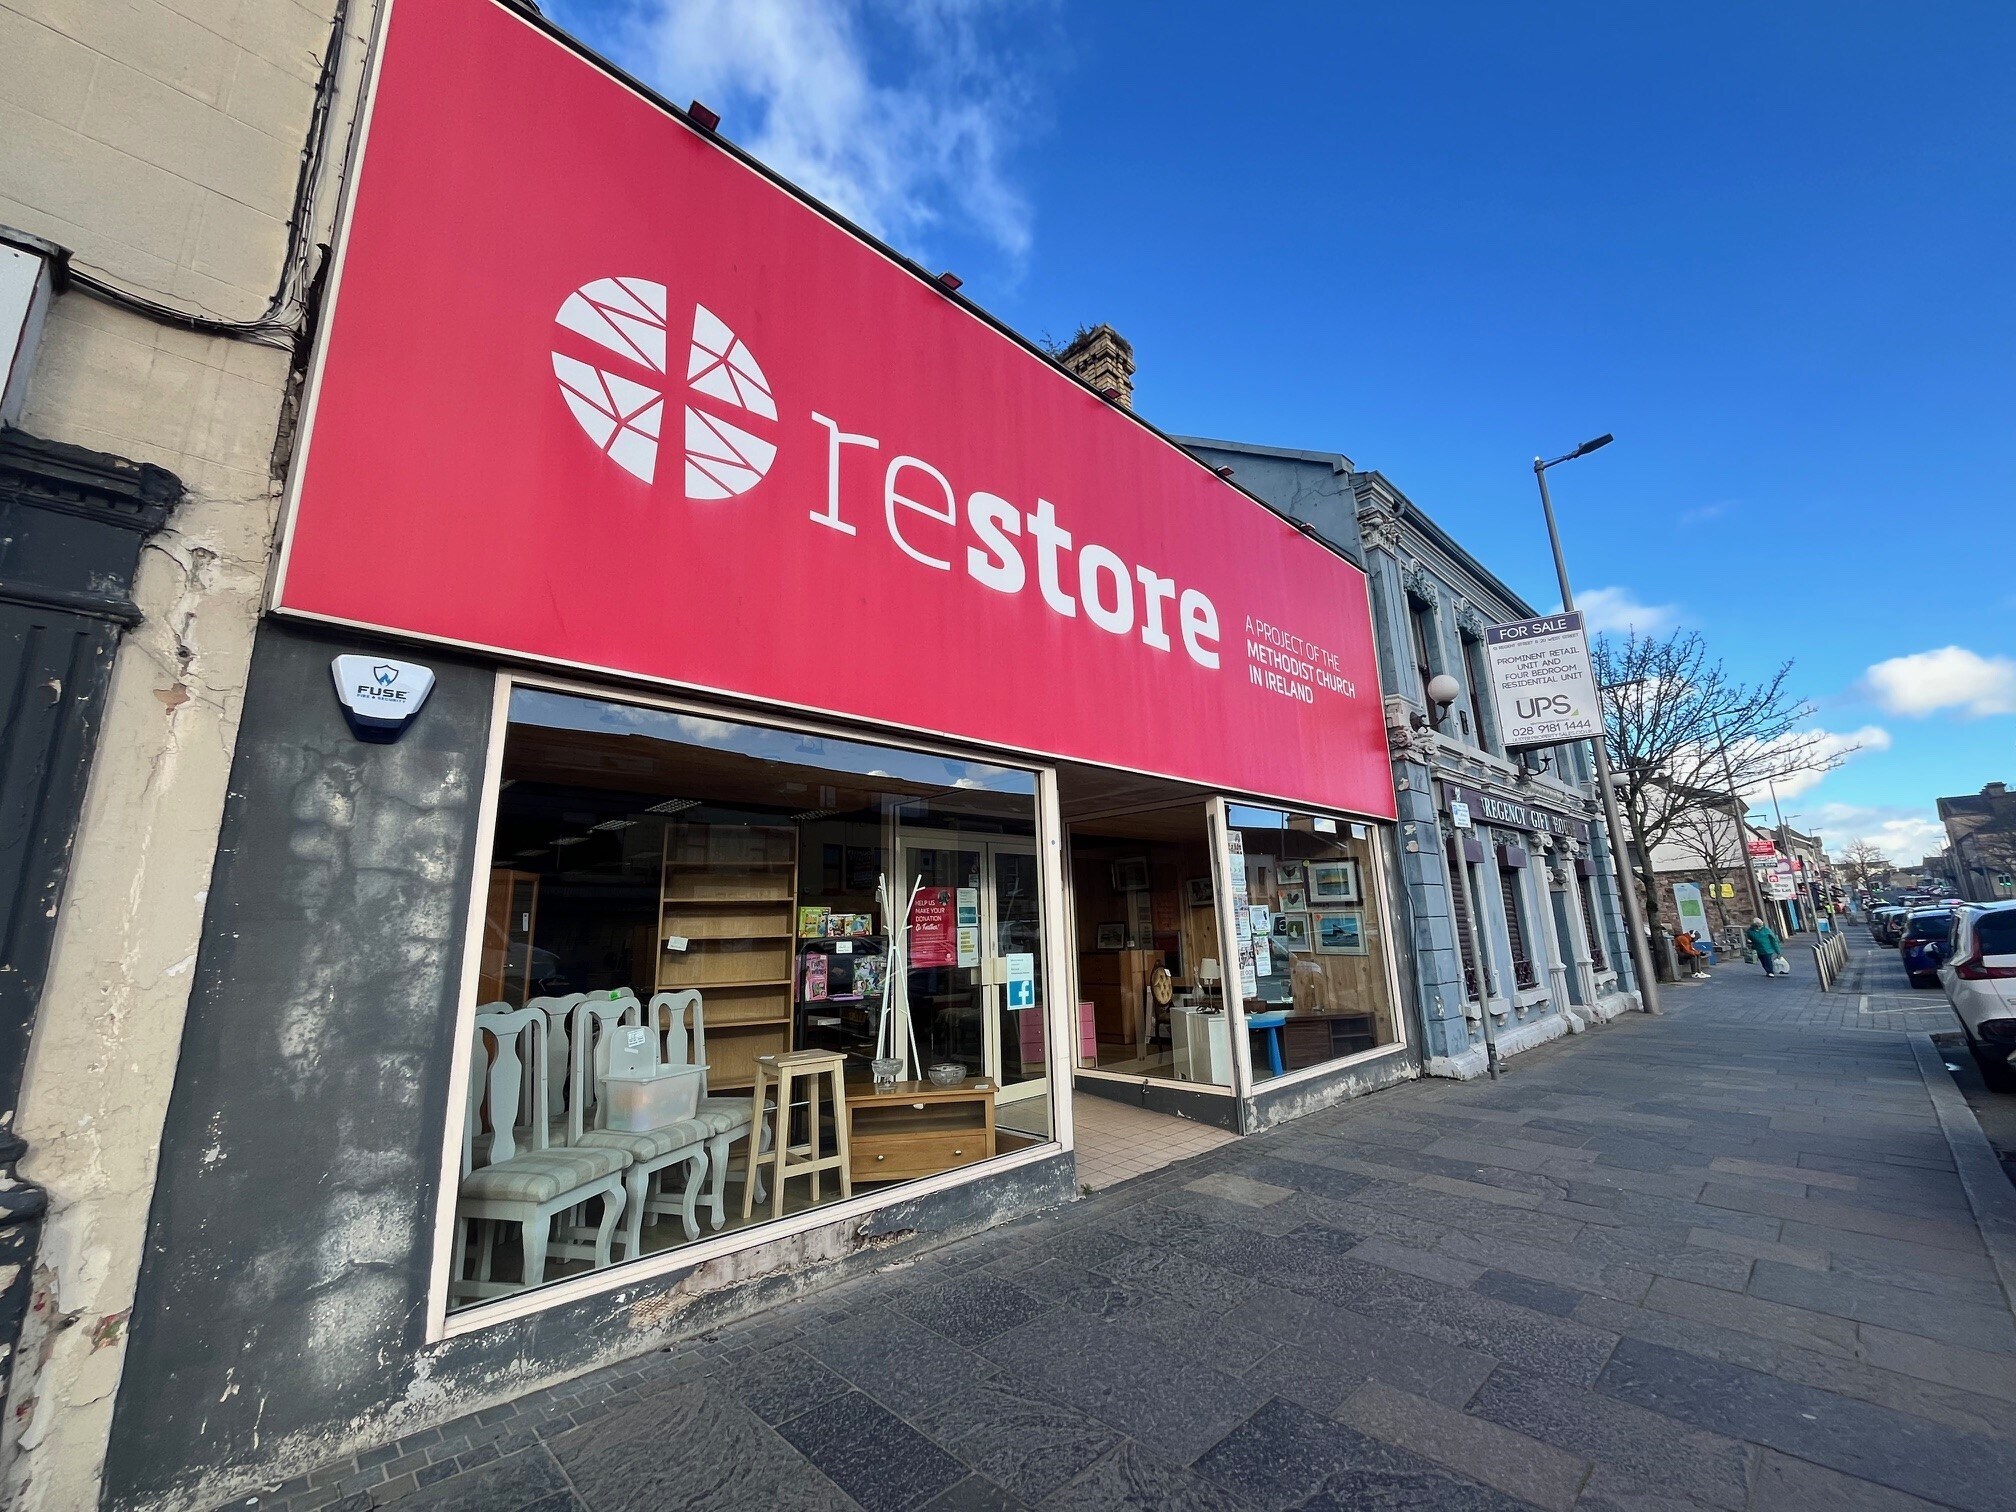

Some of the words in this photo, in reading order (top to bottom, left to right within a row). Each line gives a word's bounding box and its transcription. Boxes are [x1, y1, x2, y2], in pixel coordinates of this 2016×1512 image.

[810, 410, 1220, 670] restore
[1500, 626, 1528, 640] FOR
[1533, 619, 1567, 634] SALE
[1245, 614, 1255, 635] A
[1256, 619, 1304, 655] PROJECT
[1305, 642, 1319, 662] OF
[1321, 649, 1341, 672] THE
[1497, 652, 1546, 665] PROMINENT
[1549, 646, 1580, 657] RETAIL
[1517, 661, 1539, 671] UNIT
[1542, 657, 1561, 667] AND
[1247, 639, 1314, 682] METHODIST
[1316, 668, 1356, 699] CHURCH
[1505, 671, 1529, 681] FOUR
[1532, 664, 1577, 676] BEDROOM
[1249, 664, 1263, 687] IN
[1265, 670, 1314, 704] IRELAND
[1501, 677, 1559, 690] RESIDENTIAL
[1560, 671, 1583, 680] UNIT
[357, 685, 408, 700] FUSE
[1516, 694, 1572, 719] UPS
[1512, 726, 1534, 737] 028
[1537, 723, 1560, 734] 9181
[1564, 719, 1591, 731] 1444
[1482, 797, 1527, 826] REGENCY
[915, 915, 942, 923] DONATION
